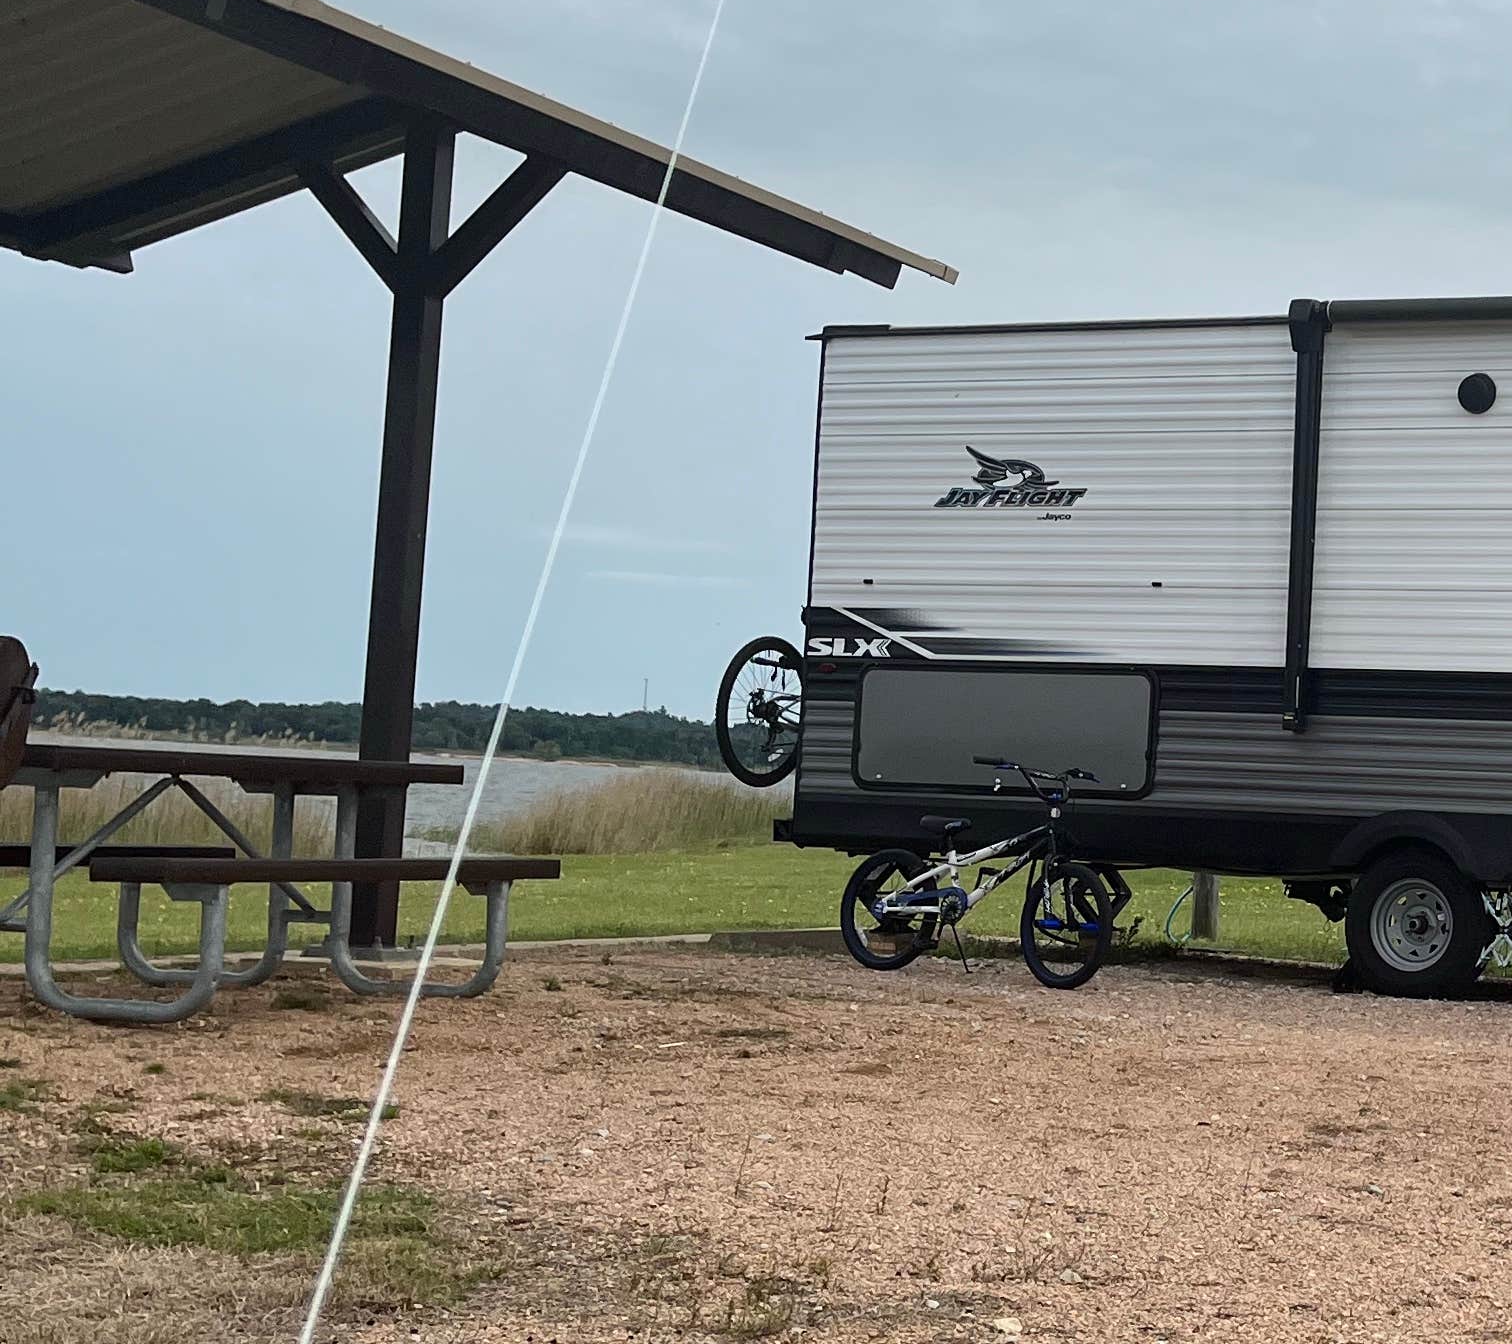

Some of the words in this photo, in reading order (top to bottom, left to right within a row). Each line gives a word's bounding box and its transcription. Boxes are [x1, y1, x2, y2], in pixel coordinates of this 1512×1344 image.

[934, 488, 991, 507] JAY
[983, 488, 1088, 507] FLIGHT
[807, 637, 892, 657] SLX
